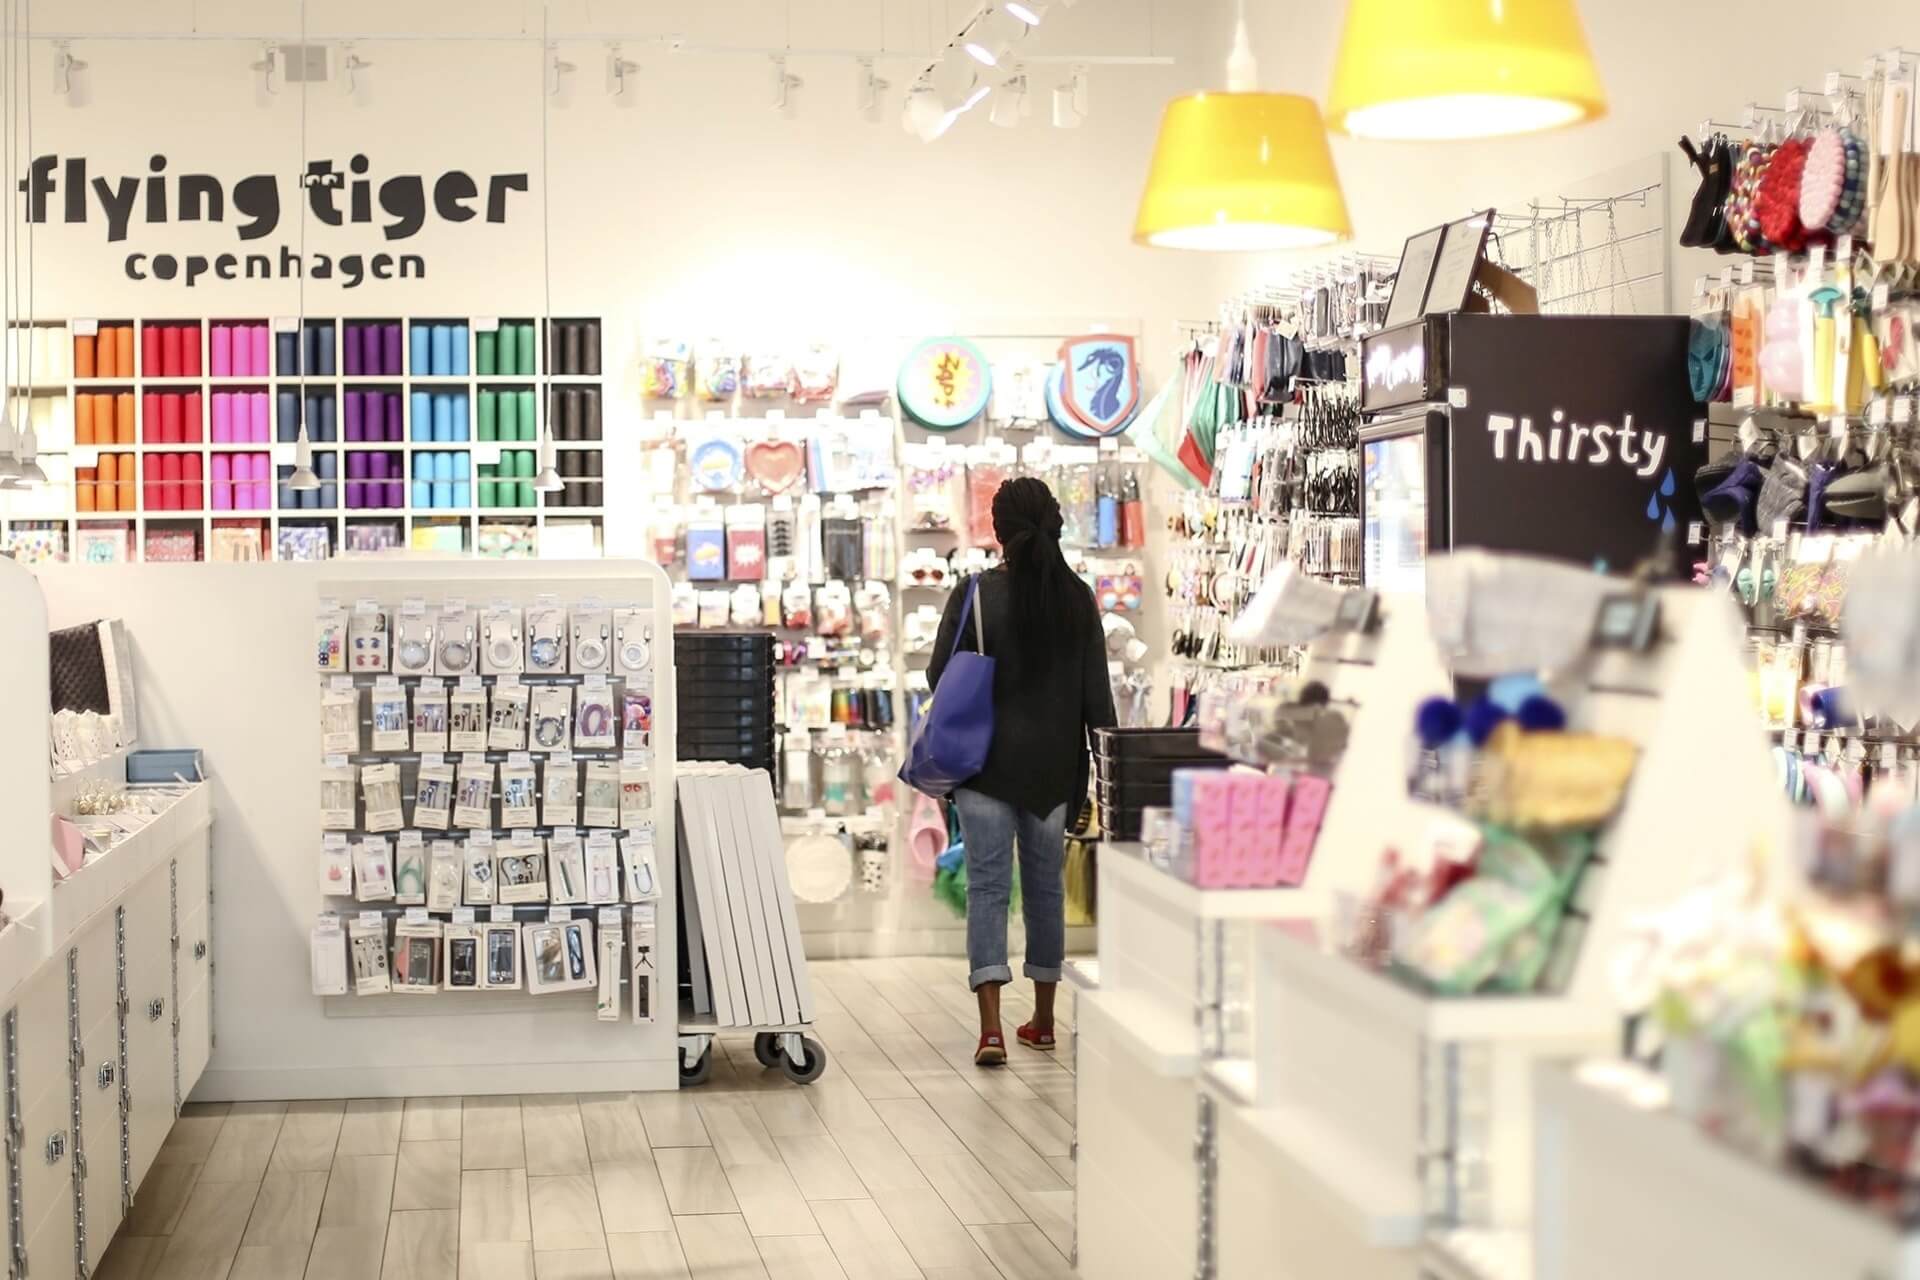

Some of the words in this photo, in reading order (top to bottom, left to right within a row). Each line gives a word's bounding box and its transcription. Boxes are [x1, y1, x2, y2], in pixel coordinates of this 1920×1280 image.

[19, 154, 281, 242] flying
[299, 153, 529, 241] tiger
[125, 245, 425, 289] copenhagen
[1487, 410, 1666, 477] Thirsty
